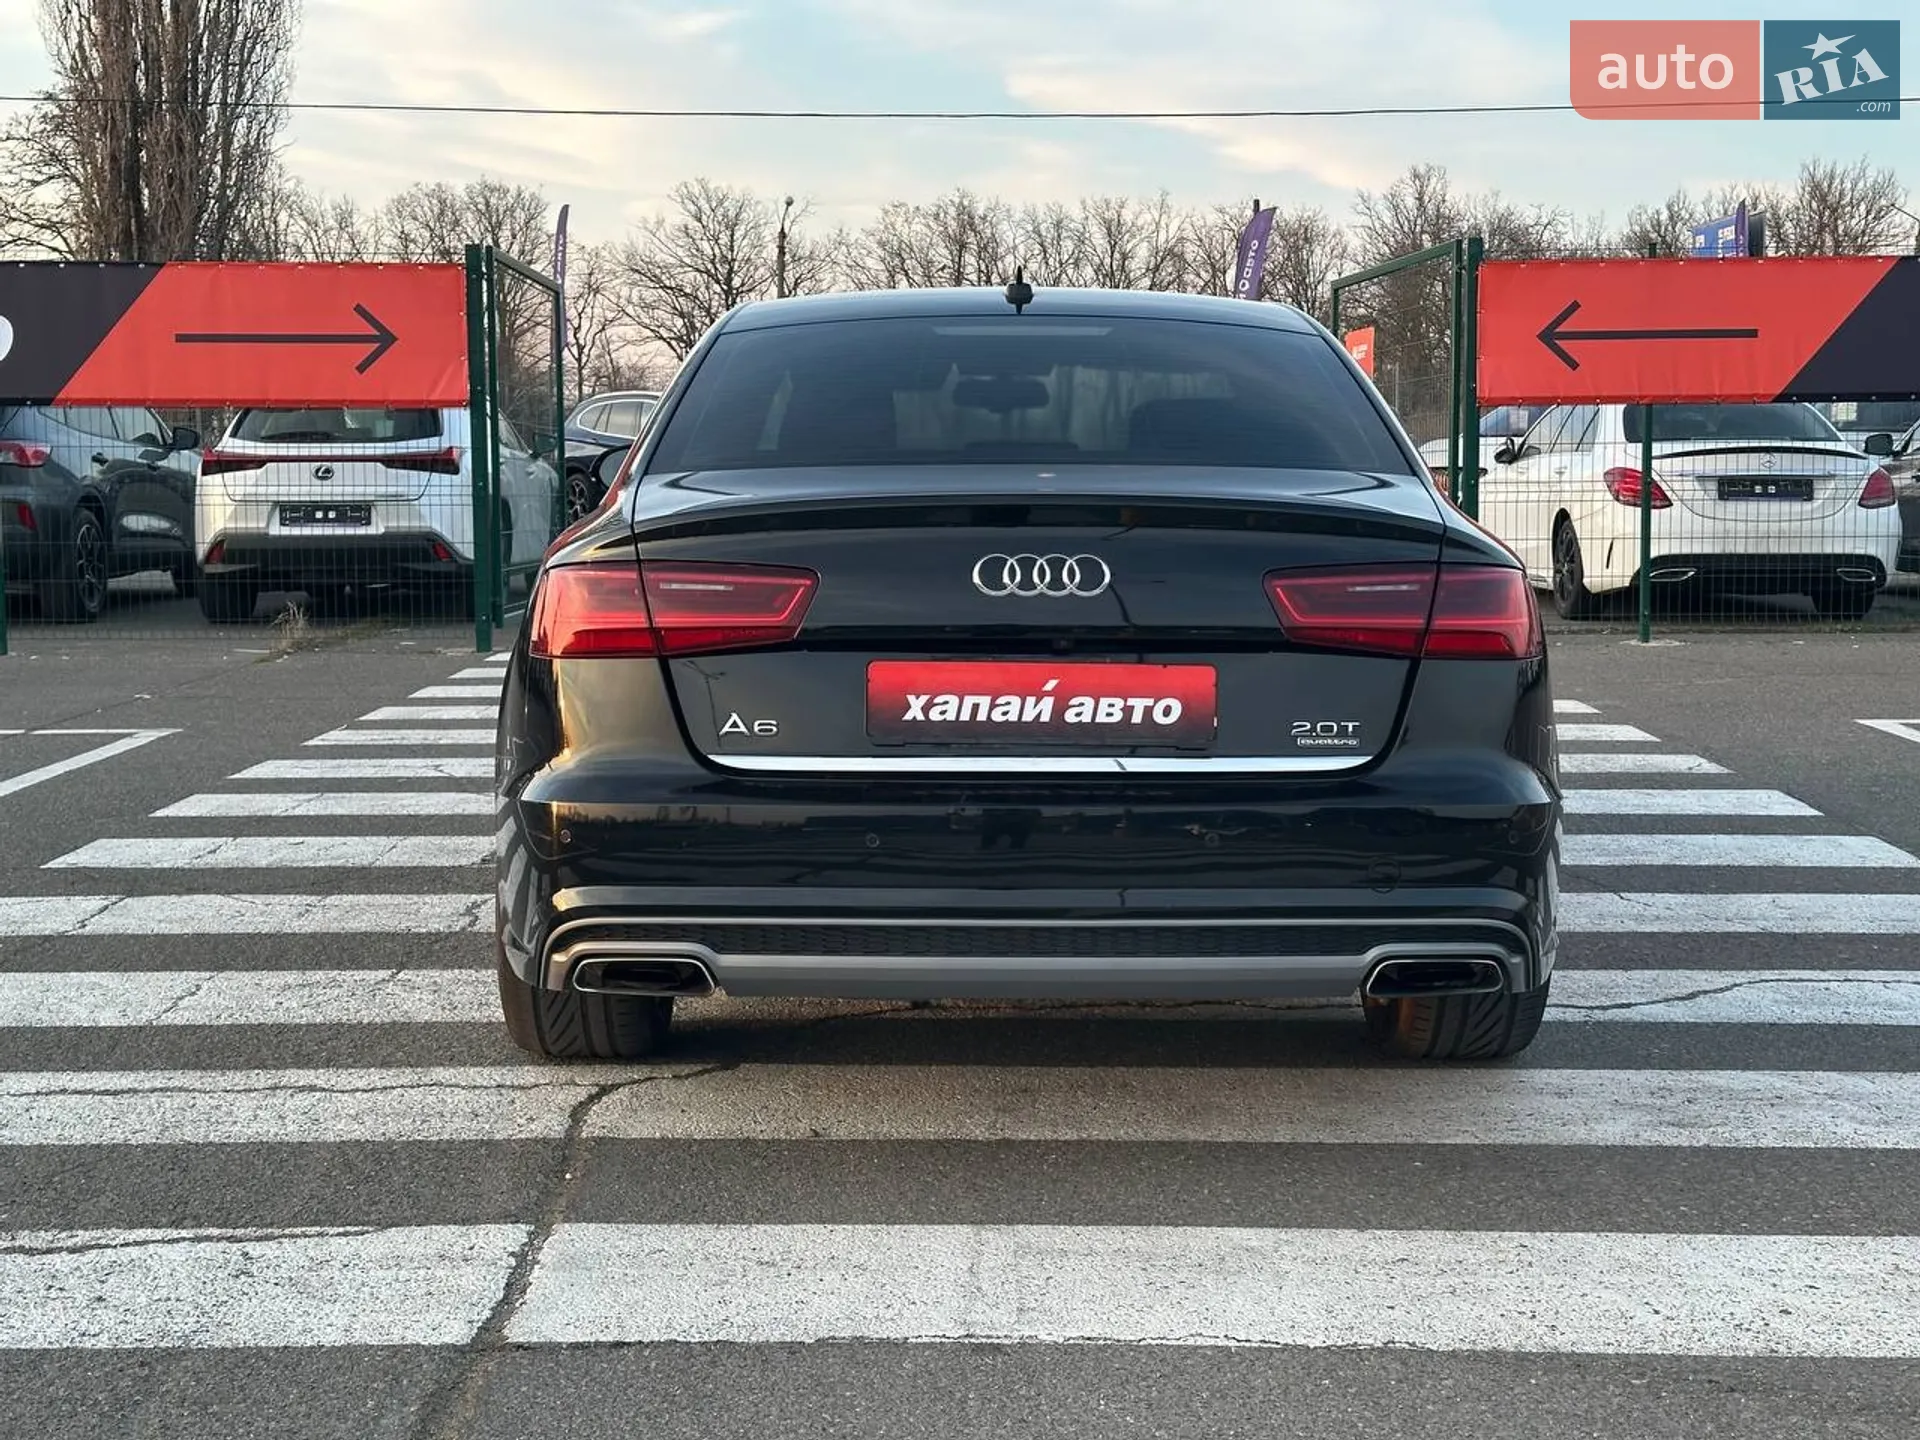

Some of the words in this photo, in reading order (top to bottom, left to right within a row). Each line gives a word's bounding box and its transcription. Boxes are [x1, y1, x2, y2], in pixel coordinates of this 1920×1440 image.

[902, 679, 1060, 722] хапай
[1064, 697, 1182, 725] авто
[719, 712, 778, 736] A6
[1291, 721, 1360, 736] 2.0T
